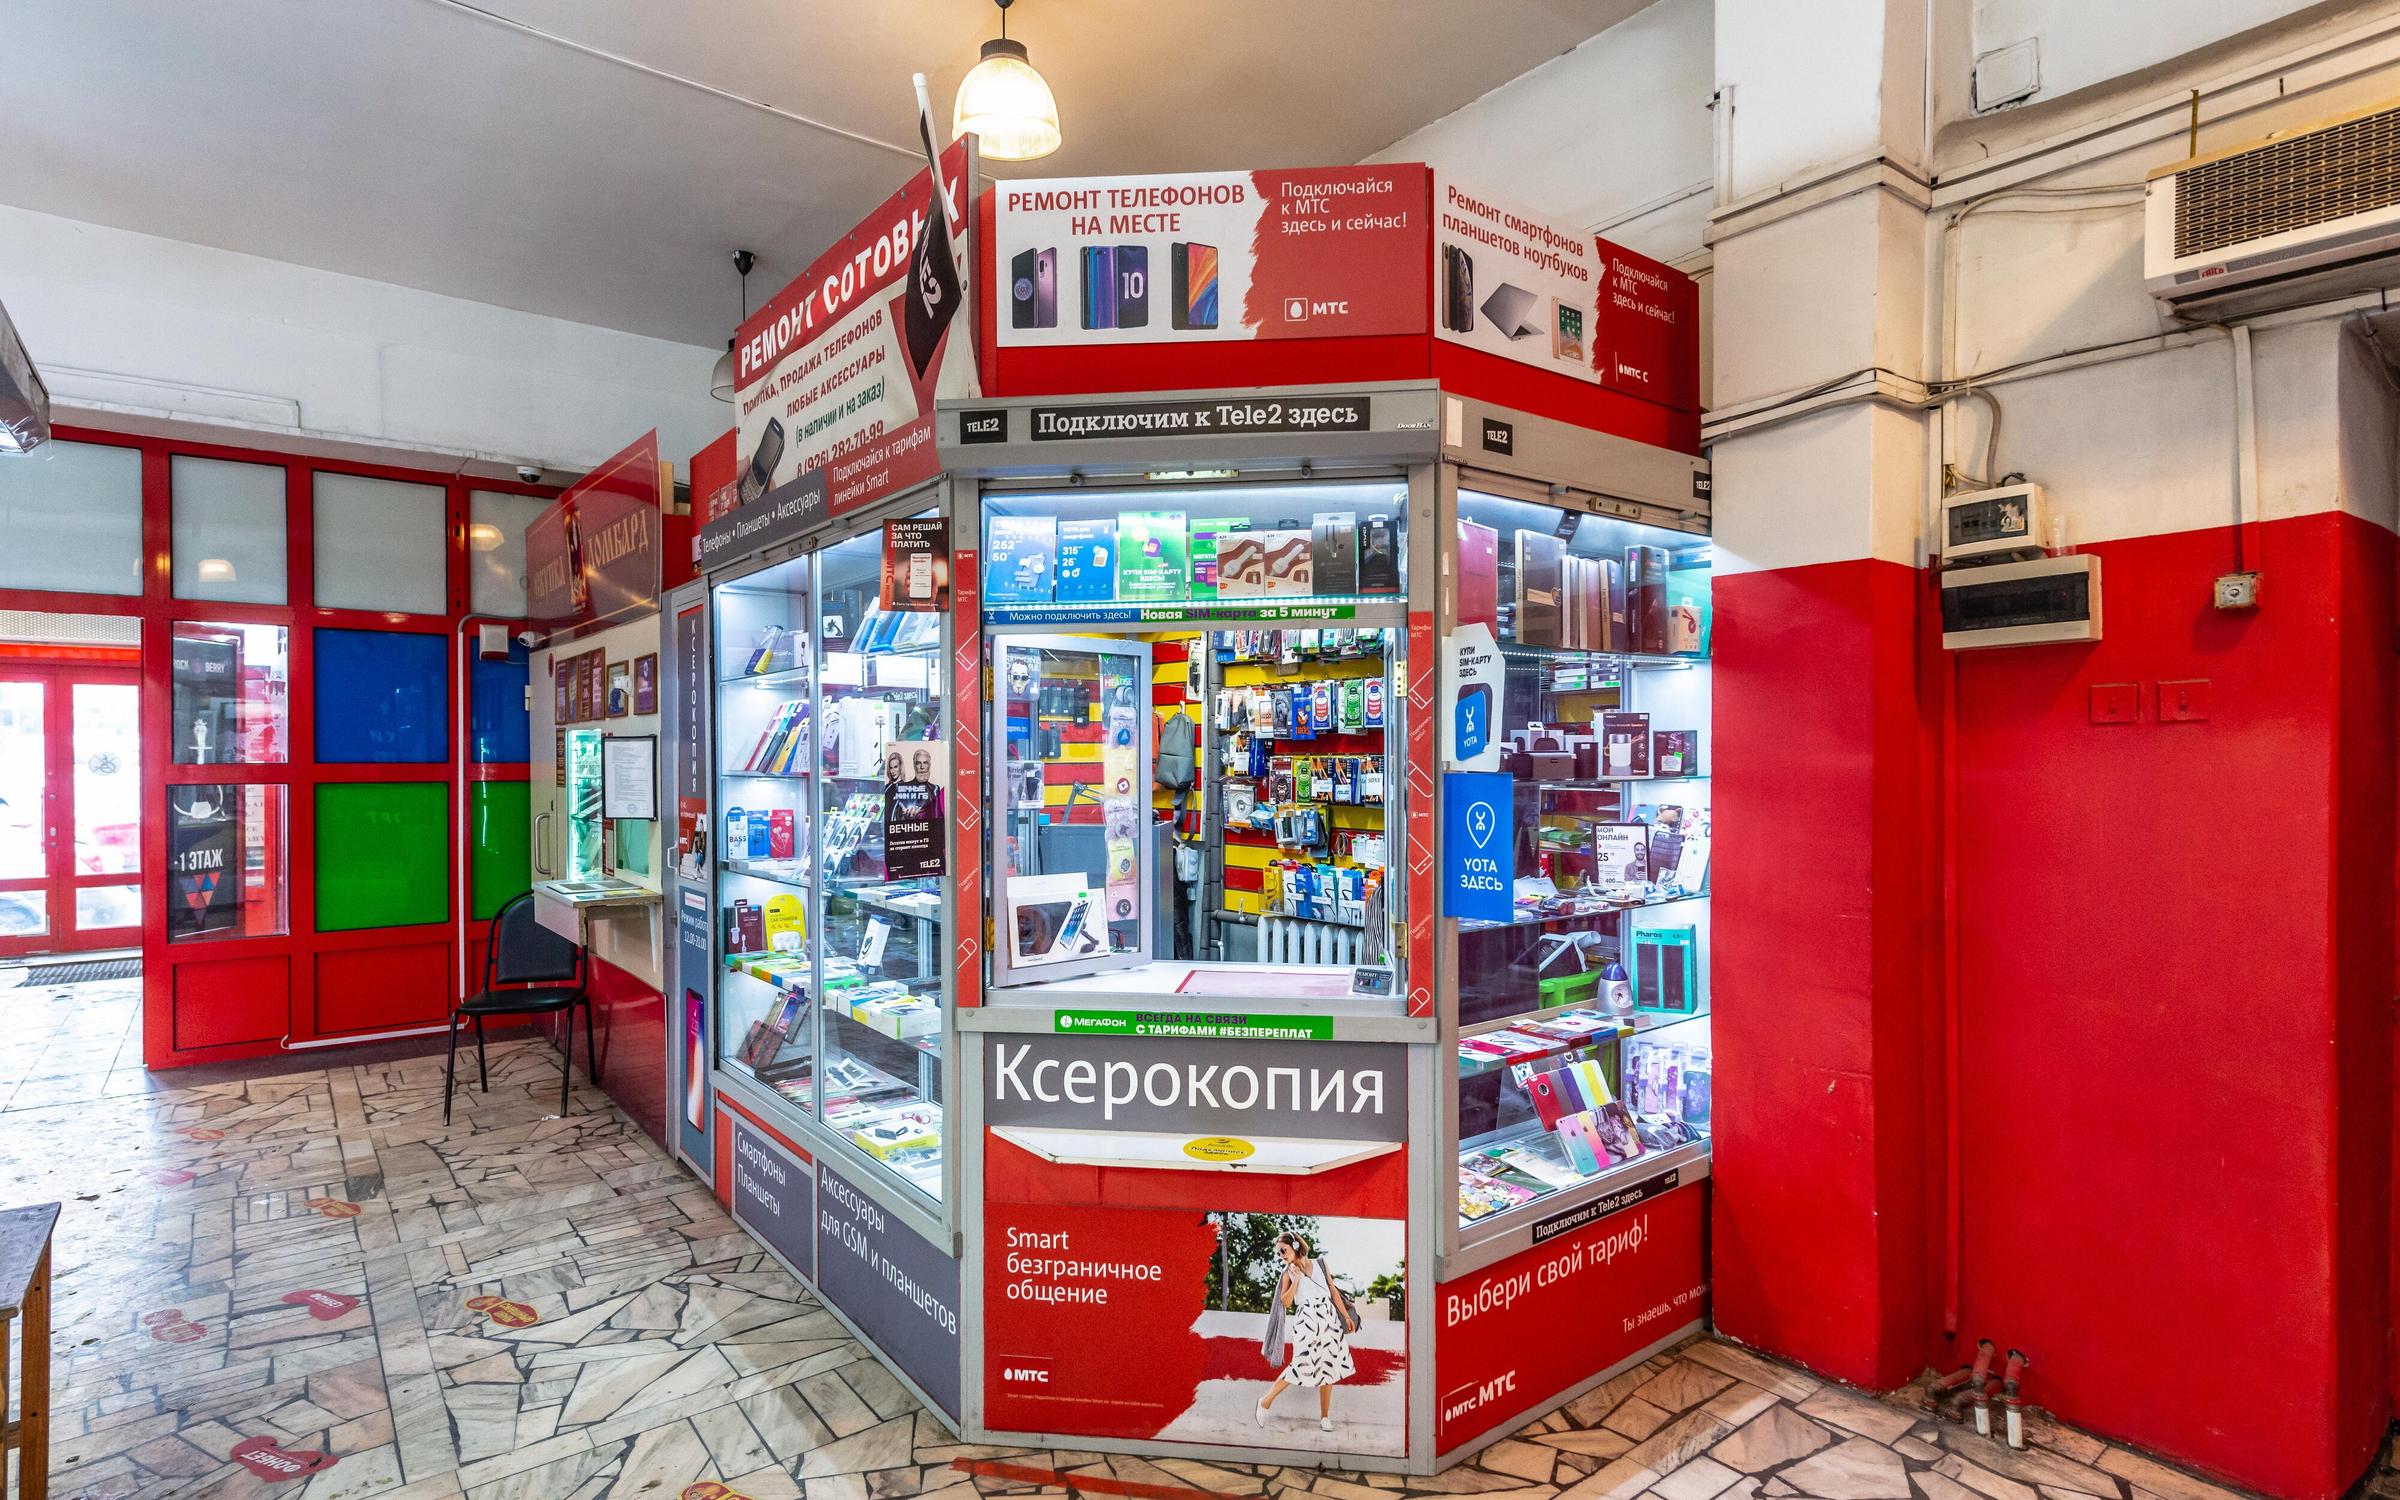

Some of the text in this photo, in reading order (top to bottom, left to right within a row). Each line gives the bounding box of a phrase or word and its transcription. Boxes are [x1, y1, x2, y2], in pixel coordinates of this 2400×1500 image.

[1008, 184, 1245, 212] РЕМОНТ ТЕЛЕФОНОВ
[1281, 179, 1393, 201] Подключайся
[1281, 200, 1330, 215] к МТС
[1072, 212, 1181, 236] НА МЕСТЕ
[1281, 211, 1407, 234] здесь и сейчас!
[1448, 185, 1583, 257] Ремонт смартфонов
[1442, 213, 1588, 282] планшетов ноутбуков
[1124, 271, 1144, 299] 10
[1612, 258, 1668, 292] Подключайся
[1612, 276, 1638, 296] к МТС
[1313, 301, 1349, 315] МТС
[1612, 292, 1675, 325] здесь и сейчас!
[741, 290, 817, 379] РЕМОНТ
[743, 309, 882, 415] ПОКУПКА, ПРОДАЖА ТЕЛЕФОНОВ
[1624, 366, 1641, 380] МТС
[786, 345, 885, 418] ЛЮБЫЕ АКСЕССУАРЫ
[804, 411, 837, 438] наличии
[838, 406, 844, 420] и
[847, 401, 855, 417] на
[857, 376, 885, 409] заказ)
[966, 417, 1000, 433] TELE2
[1038, 404, 1359, 435] Подключим к Tele2 здесь
[1486, 429, 1508, 444] TELE2
[832, 425, 931, 484] Подключайся к тарифам
[834, 469, 889, 507] линейки Smart
[702, 531, 731, 554] Телефоны
[736, 512, 770, 540] Планшеты
[777, 488, 821, 522] Аксессуары
[891, 521, 943, 532] САМ РЕШАЙ
[588, 509, 649, 571] ЛОМБАРД
[891, 532, 922, 540] ЗА ЧТО
[891, 540, 931, 549] ПЛАТИТЬ
[1009, 609, 1132, 624] Можно подключить здесь!
[1140, 609, 1183, 620] Новая
[1260, 608, 1277, 617] за
[1279, 607, 1289, 617] 5
[1291, 607, 1338, 618] минут
[1459, 646, 1476, 656] КУПИ
[1459, 655, 1492, 667] SIM-КАРТУ
[205, 662, 225, 673] BERRY
[1459, 668, 1477, 677] ЗДЕСЬ
[1463, 736, 1478, 748] YOTA
[889, 822, 929, 834] ВЕЧНЫЕ
[1597, 833, 1629, 841] ОНЛАЙН
[189, 848, 224, 871] ЭТАЖ
[920, 859, 940, 869] TELE2
[1463, 858, 1498, 873] YOTA
[1597, 852, 1609, 862] 25
[1460, 874, 1504, 891] ЗДЕСЬ
[1636, 930, 1663, 938] Pharos
[1136, 1013, 1181, 1024] ВСЕГДА
[1185, 1014, 1201, 1024] НА
[1206, 1014, 1247, 1025] СВЯЗИ
[1136, 1024, 1312, 1039] С ТАРИФАМИ #БЕЗПЕРЕПЛАТ
[996, 1044, 1384, 1120] Ксерокопия
[737, 1131, 786, 1187] Смартфоны
[737, 1163, 780, 1217] Планшеты
[821, 1167, 885, 1234] Аксессуары
[1536, 1189, 1643, 1239] Подключим к Tele2 здесь
[1007, 1227, 1069, 1250] Smart
[821, 1209, 957, 1335] для GSM и планшетов
[1007, 1254, 1162, 1280] безграничное
[1447, 1214, 1648, 1327] Выбери свой тариф!
[1007, 1282, 1108, 1305] общение
[1623, 1318, 1635, 1333] Ты
[1637, 1302, 1672, 1327] знаешь,
[1673, 1293, 1688, 1306] что
[1014, 1368, 1049, 1383] МТС
[1452, 1371, 1516, 1419] МТС МТС
